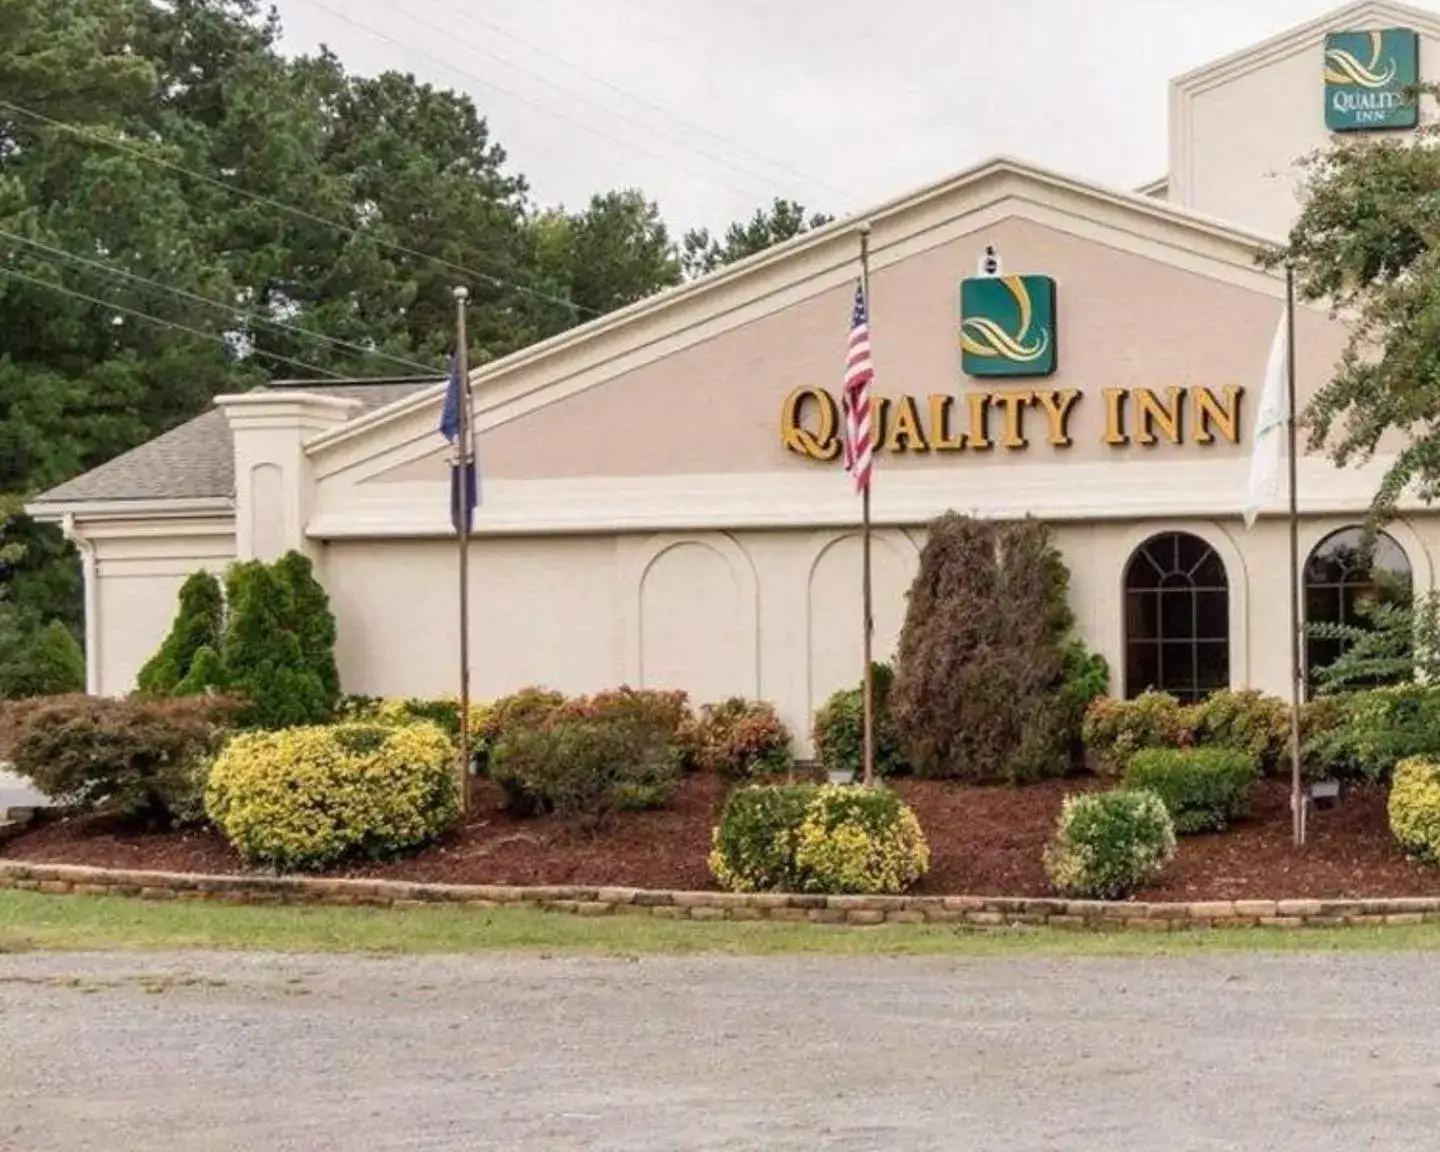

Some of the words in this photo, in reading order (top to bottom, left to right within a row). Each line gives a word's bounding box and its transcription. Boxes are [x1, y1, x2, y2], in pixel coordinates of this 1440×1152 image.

[1332, 90, 1402, 114] QUALIT
[1355, 110, 1386, 123] INN
[1103, 384, 1245, 445] INN
